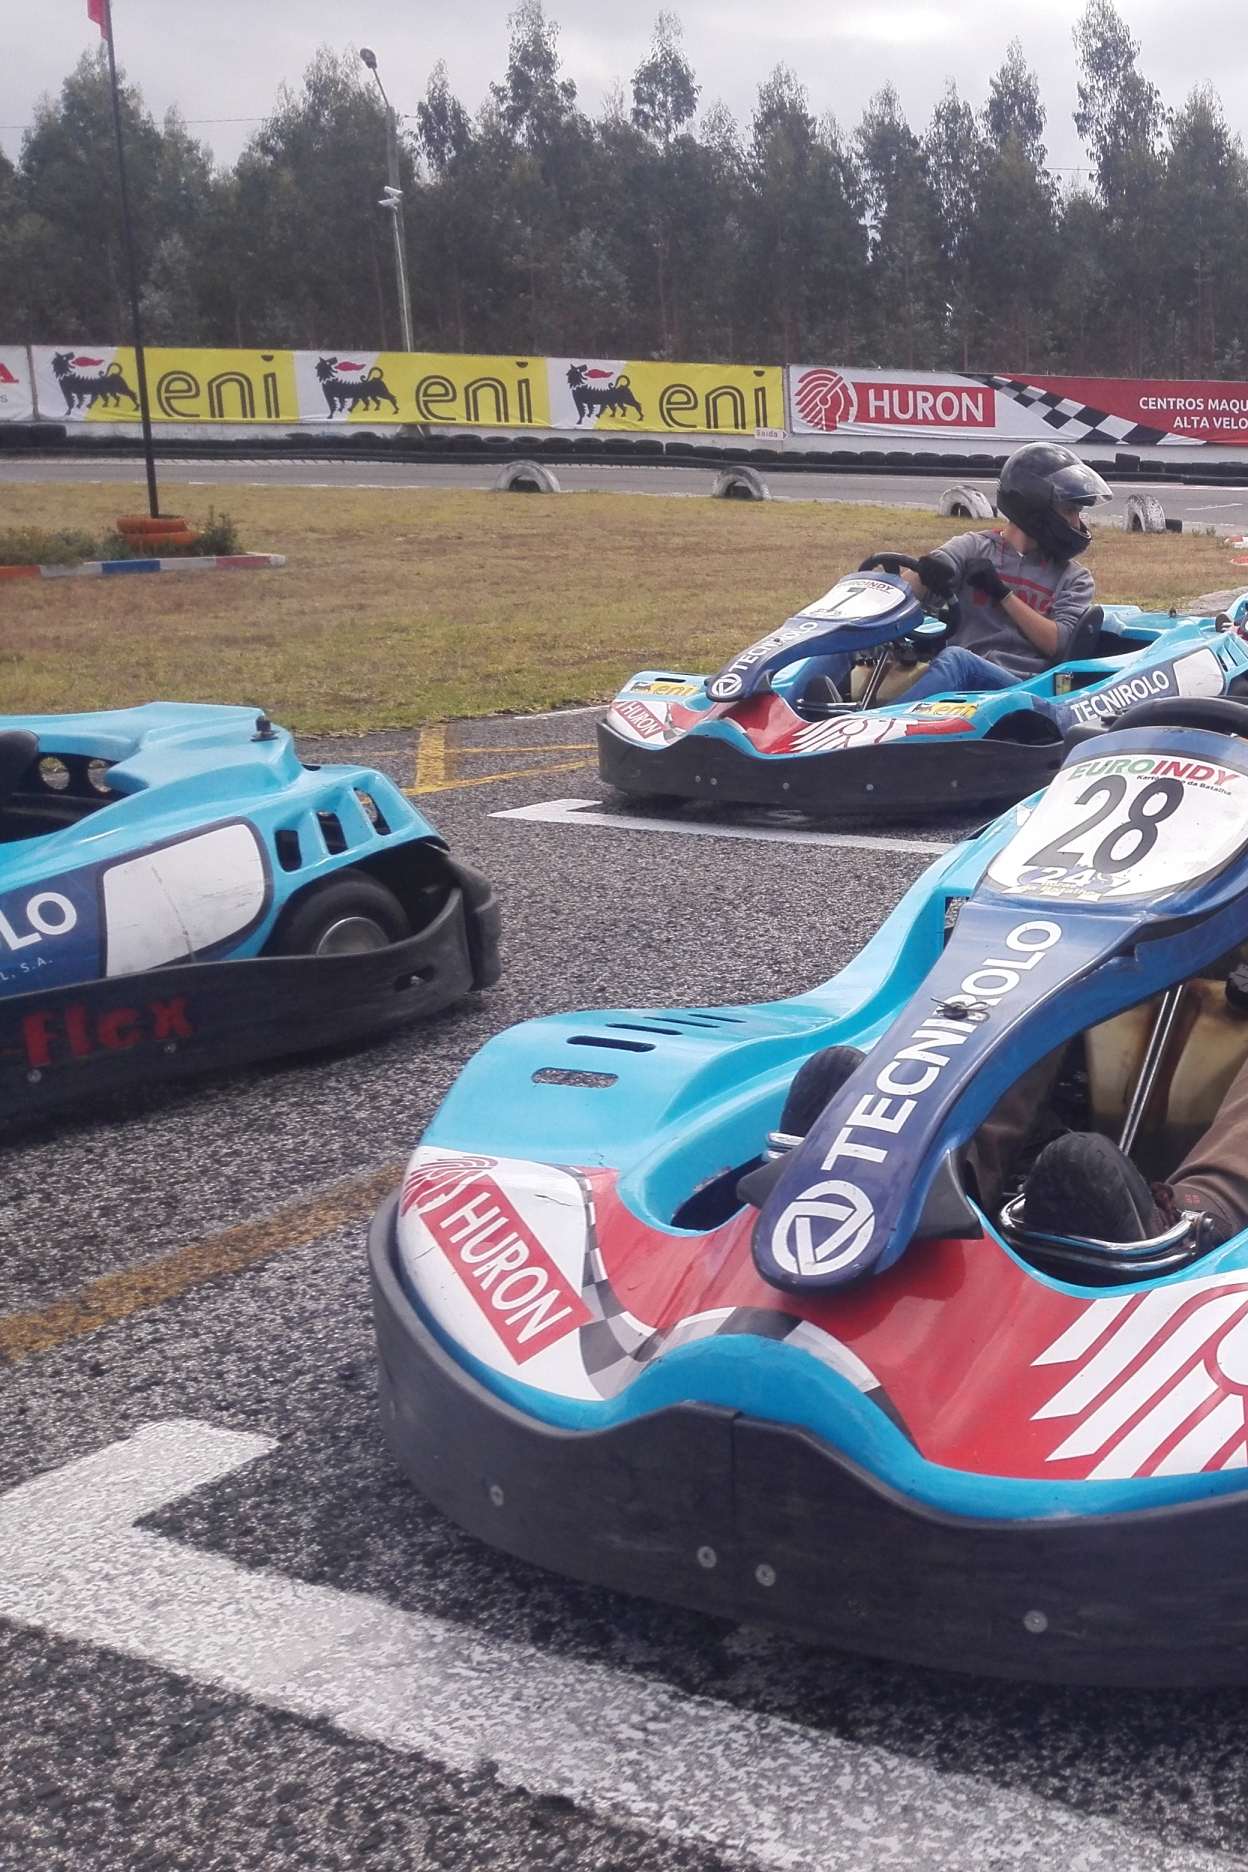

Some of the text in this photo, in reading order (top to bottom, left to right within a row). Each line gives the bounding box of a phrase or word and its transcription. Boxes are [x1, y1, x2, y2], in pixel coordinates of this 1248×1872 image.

[156, 355, 280, 418] eni
[415, 361, 532, 423] eni
[659, 370, 767, 429] eni
[867, 388, 984, 423] HURON
[1139, 397, 1204, 410] CENTROS
[1173, 416, 1209, 428] ALTA
[622, 702, 660, 737] HURON
[1070, 669, 1170, 724] TECNIROLO
[1067, 759, 1241, 786] EUROINDY
[1200, 783, 1232, 796] Batalha
[1023, 774, 1184, 875] 28
[821, 920, 1063, 1171] TECNIROLO
[440, 1191, 573, 1344] HURON
